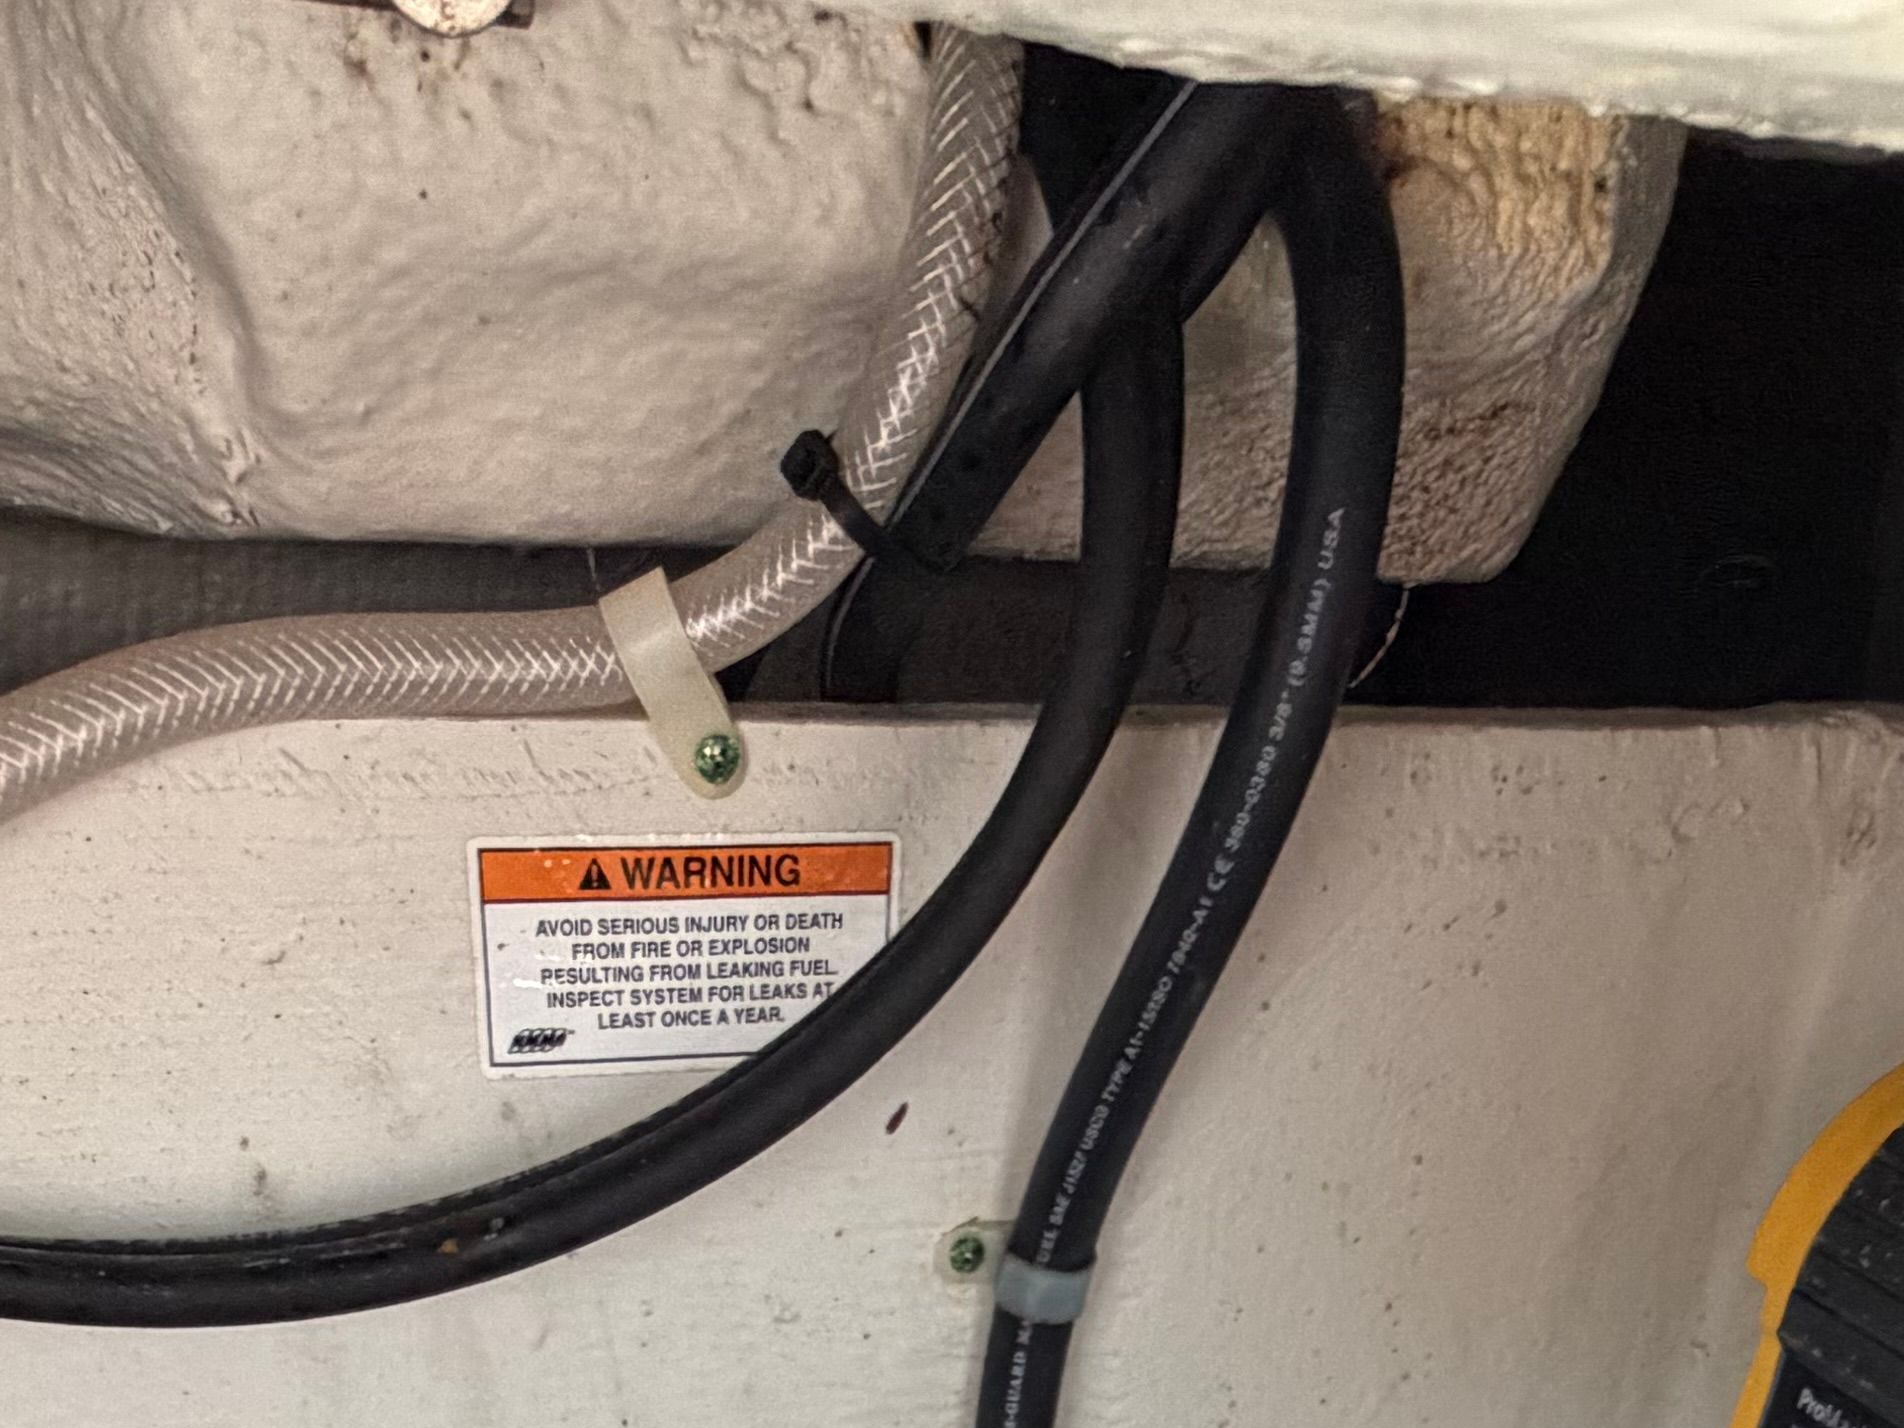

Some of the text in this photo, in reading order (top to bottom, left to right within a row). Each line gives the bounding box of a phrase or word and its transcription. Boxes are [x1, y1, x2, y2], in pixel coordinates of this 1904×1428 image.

[1102, 1060, 1133, 1102] TYPE
[1317, 507, 1345, 570] USA
[621, 854, 801, 890] WARNING
[536, 912, 843, 937] AVOID SERIOUS INJURY OR DEATH
[571, 937, 810, 961] FROM FIRE OR EXPLOSION
[540, 960, 784, 985] RESULTING FROM LEAKING
[546, 981, 835, 1009] INSPECT SYSTEM FOR LEAKS AT
[597, 1006, 786, 1030] LEAST ONCE A YEAR.
